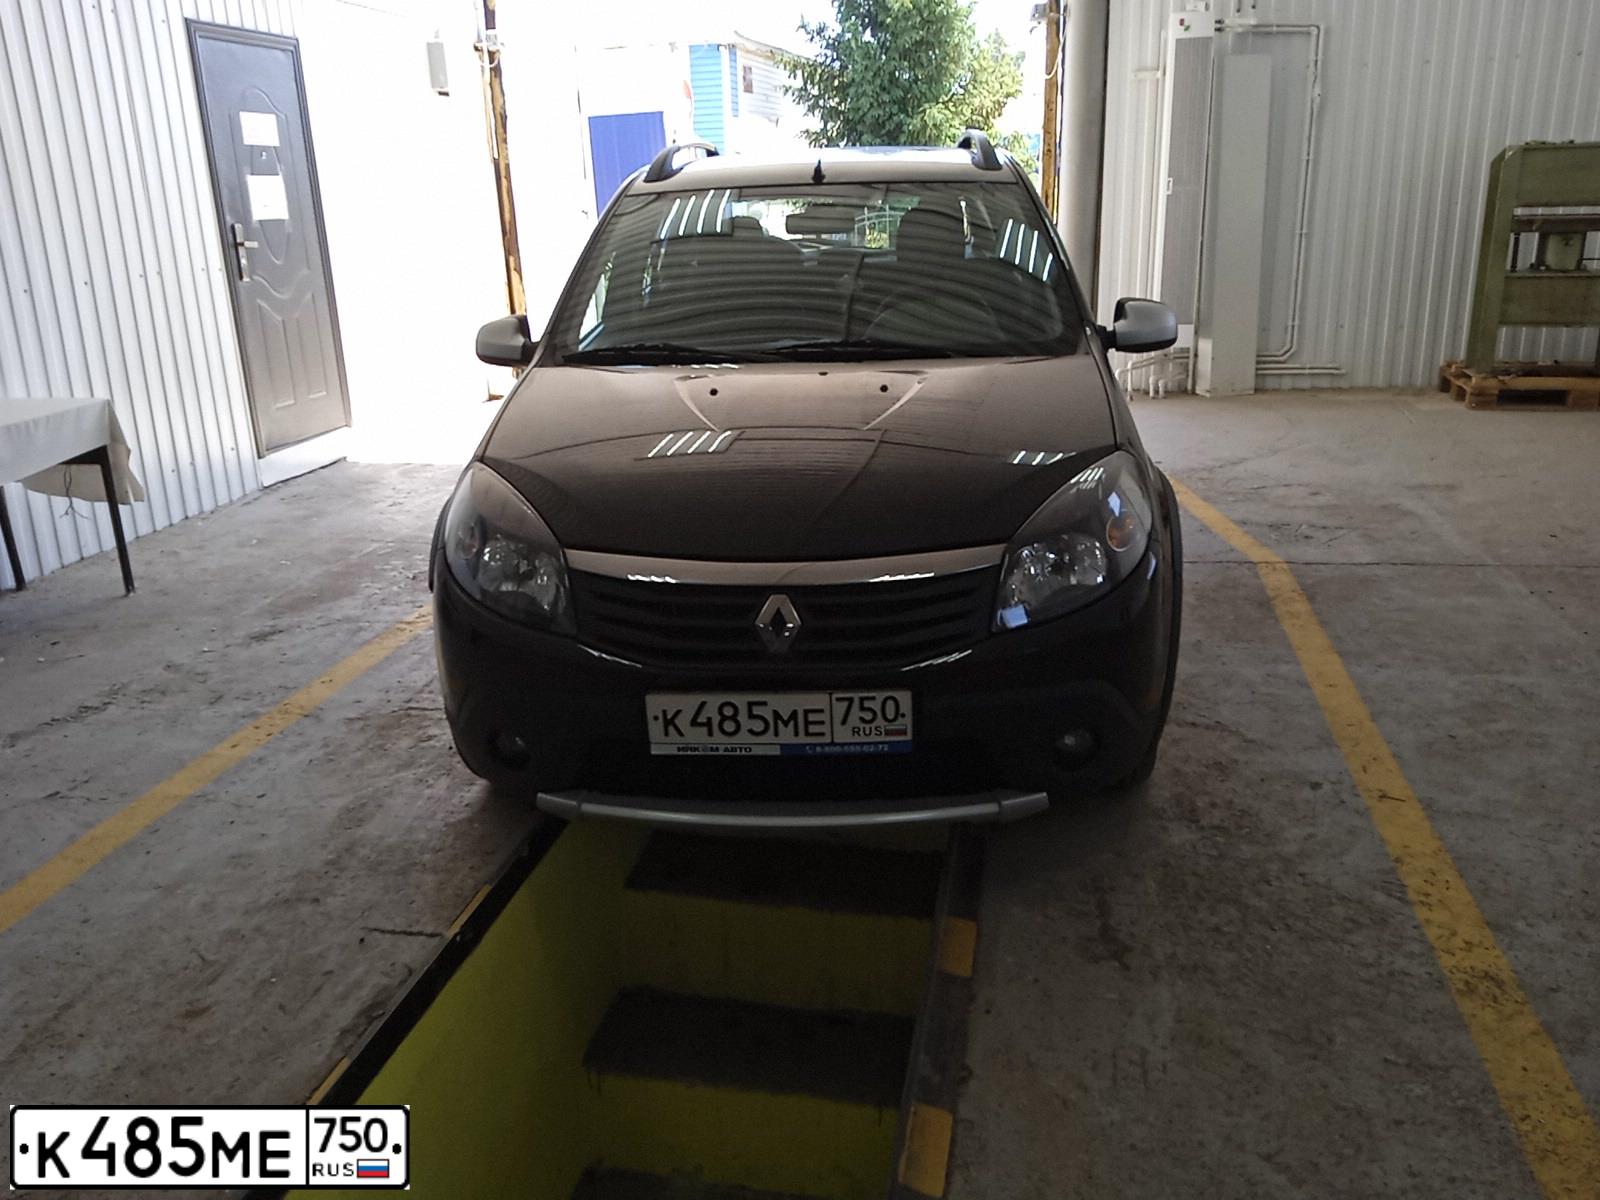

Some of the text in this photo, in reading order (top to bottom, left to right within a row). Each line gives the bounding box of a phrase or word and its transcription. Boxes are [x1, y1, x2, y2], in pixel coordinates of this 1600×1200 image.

[661, 700, 827, 738] К485МЕ
[835, 695, 901, 727] 750
[851, 725, 883, 737] RUS
